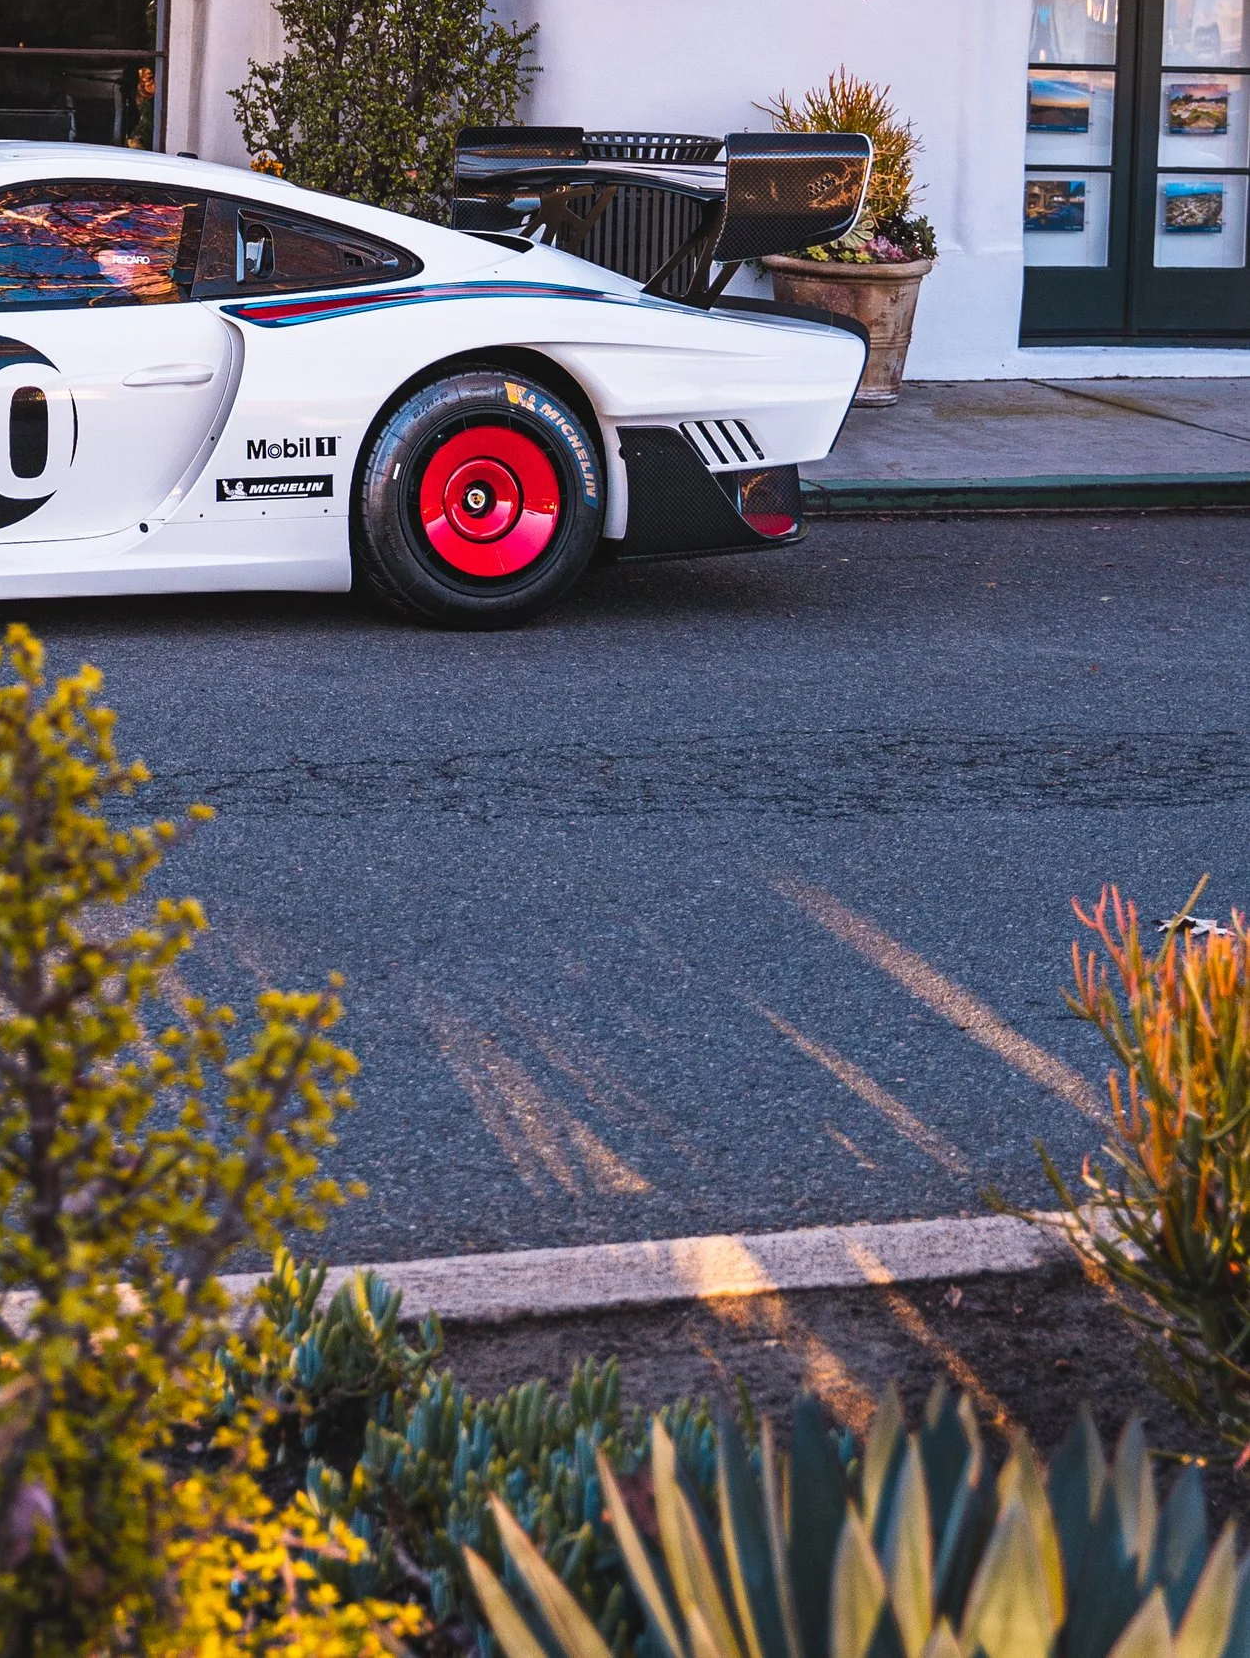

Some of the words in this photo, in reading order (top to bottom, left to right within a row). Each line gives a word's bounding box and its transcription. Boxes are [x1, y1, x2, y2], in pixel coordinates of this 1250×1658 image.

[112, 255, 151, 265] RECARO
[246, 437, 311, 460] Mobil
[538, 402, 597, 499] MICHELIN
[248, 481, 325, 494] MICHELIN
